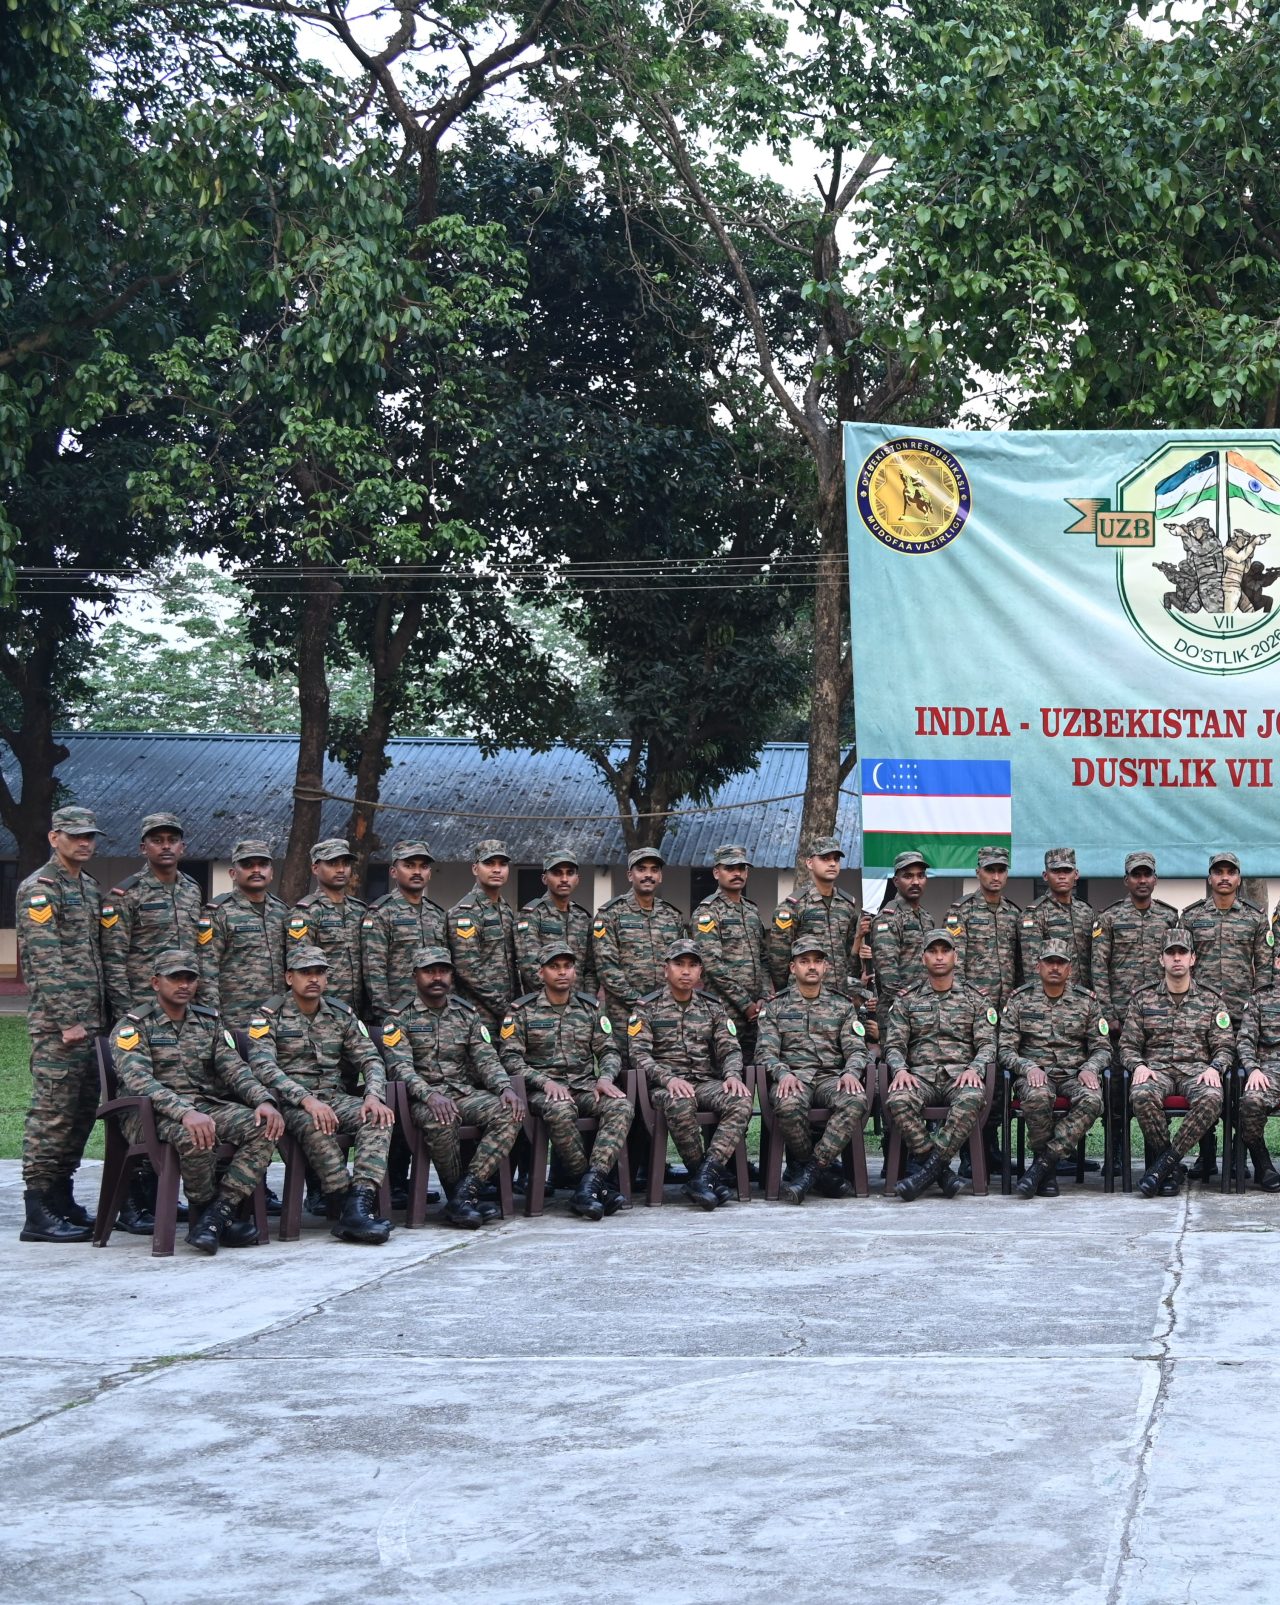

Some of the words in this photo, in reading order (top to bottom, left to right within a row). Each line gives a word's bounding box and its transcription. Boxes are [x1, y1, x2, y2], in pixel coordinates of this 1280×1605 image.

[911, 441, 966, 490] RESPUBLIKASI
[867, 515, 912, 551] MUDOFAA
[915, 517, 963, 551] VAZIRLIGI
[1099, 518, 1150, 540] UZB
[1213, 615, 1234, 629] VII
[1173, 637, 1250, 664] DO'STLIK
[914, 706, 1011, 736] INDIA
[1039, 707, 1247, 739] UZBEKISTAN
[1071, 757, 1217, 788] DUSTLIK
[1225, 758, 1273, 788] VII
